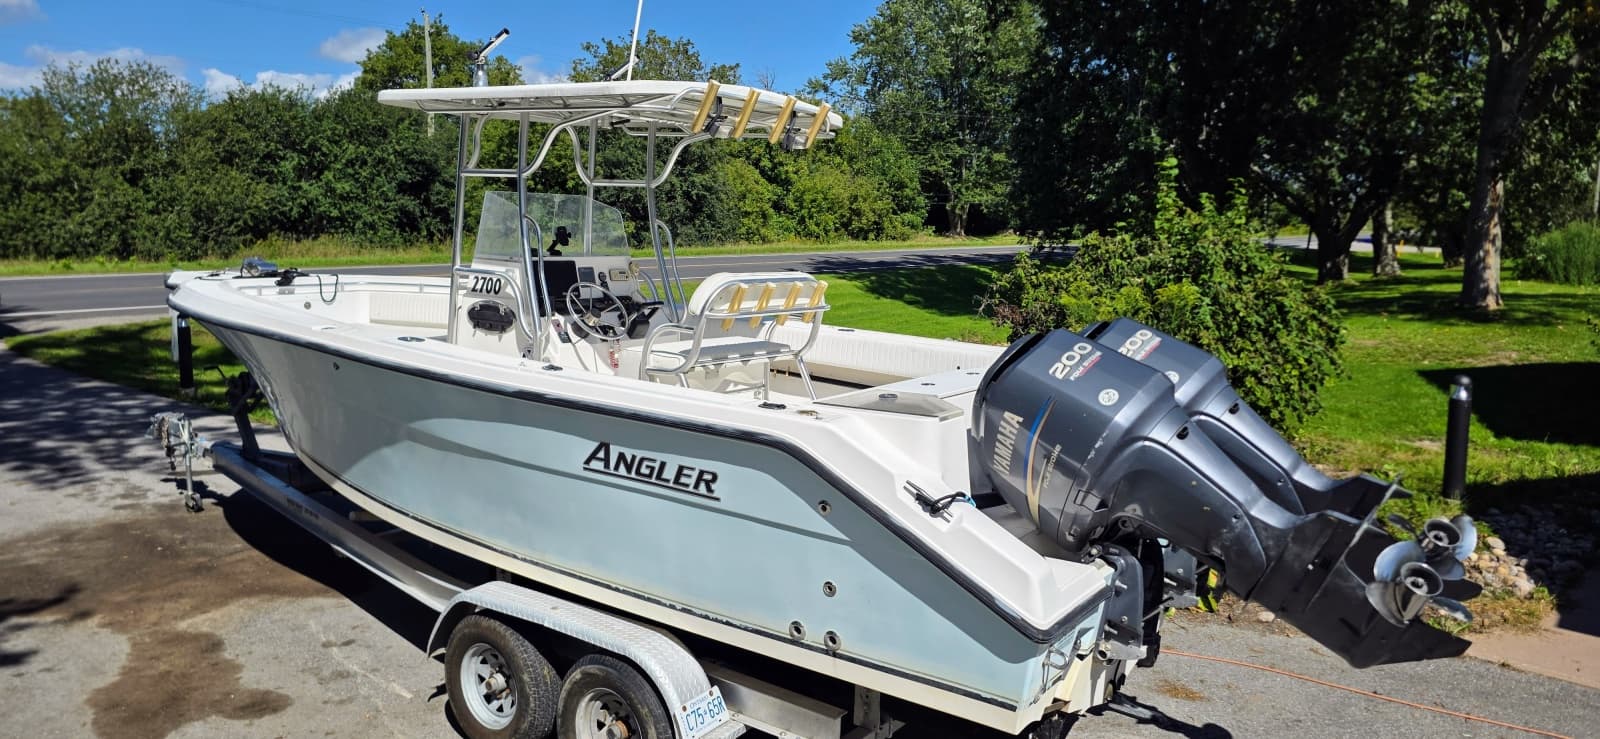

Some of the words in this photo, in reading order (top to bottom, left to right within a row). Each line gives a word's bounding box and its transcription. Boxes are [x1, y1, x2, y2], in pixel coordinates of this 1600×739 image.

[471, 276, 502, 295] 2700
[1048, 342, 1092, 380] 200
[1118, 329, 1153, 358] 200
[993, 411, 1024, 479] YAMAHA
[583, 441, 718, 495] ANGLER
